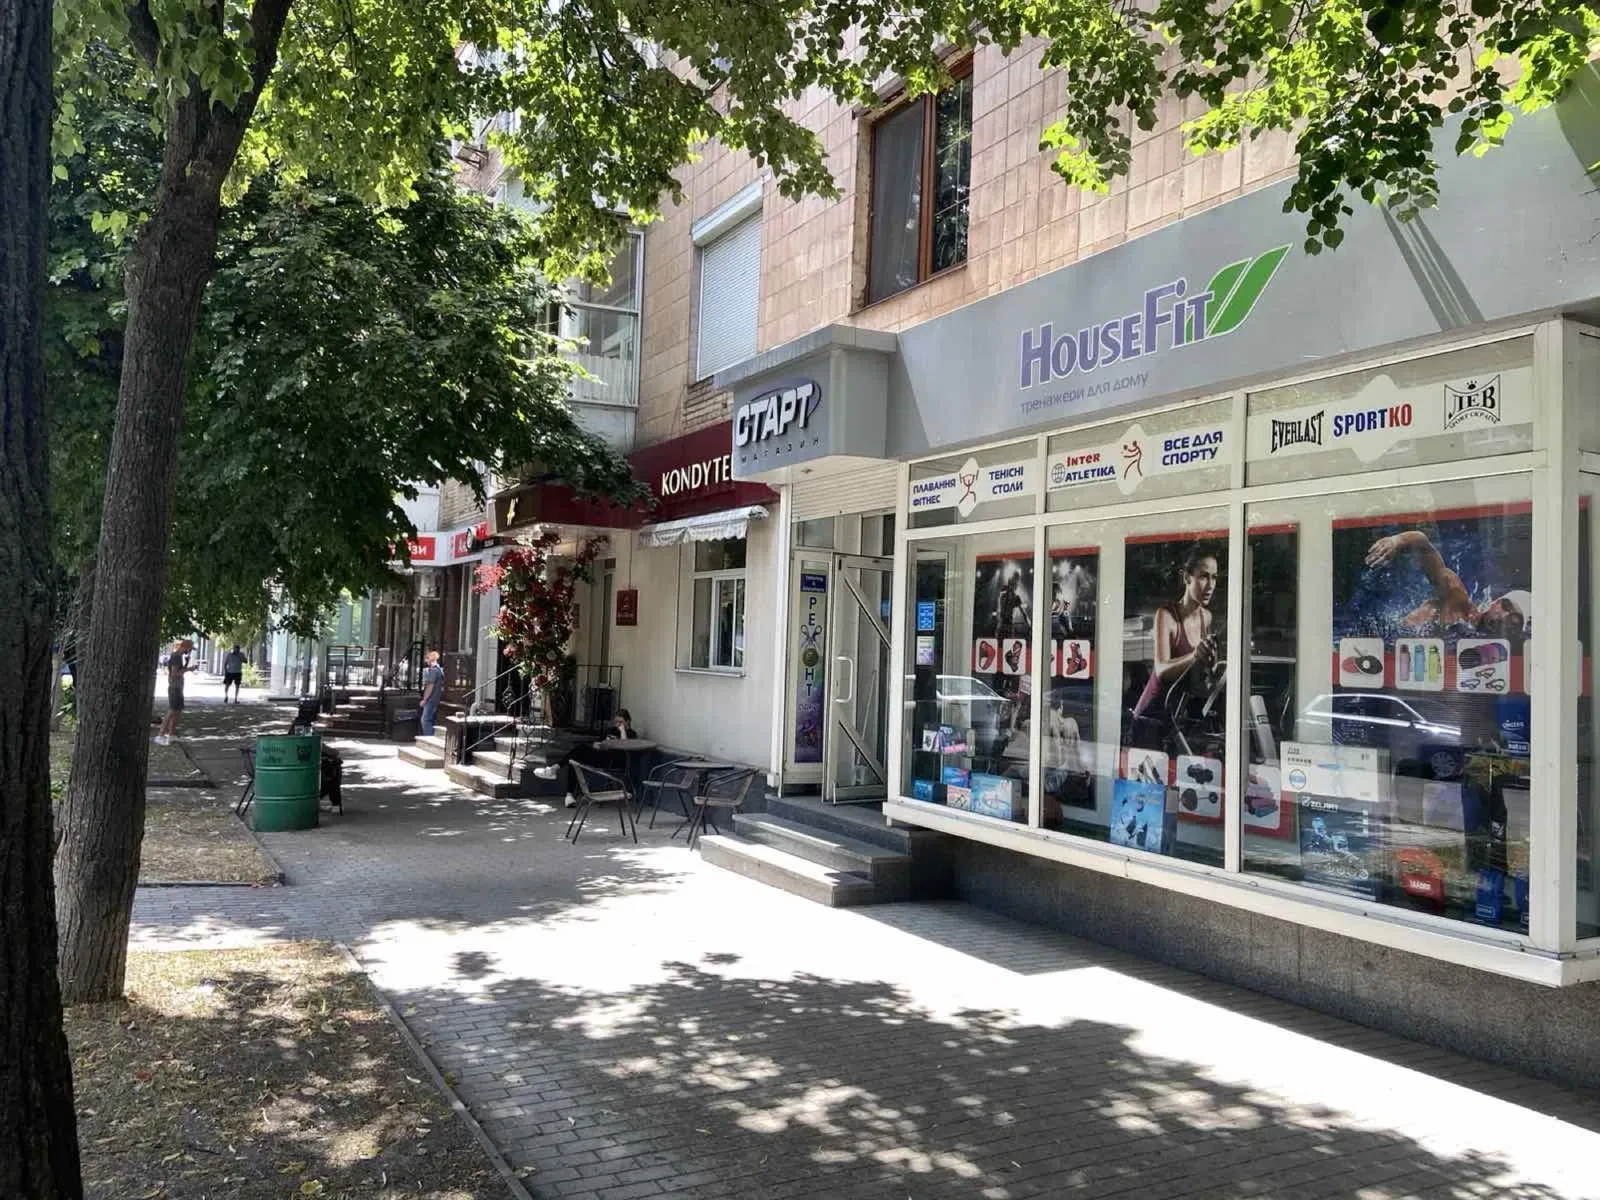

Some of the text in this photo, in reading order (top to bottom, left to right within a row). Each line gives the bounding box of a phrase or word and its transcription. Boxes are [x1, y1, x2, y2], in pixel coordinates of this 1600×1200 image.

[1020, 372, 1149, 415] тренажери для дому
[735, 383, 814, 447] СТАРТ
[1333, 404, 1413, 437] SPORTKO
[1163, 430, 1223, 451] ВСЕ ДЛЯ
[1271, 410, 1324, 453] EVERLAST
[1162, 447, 1219, 467] СПОРТУ
[988, 466, 1024, 481] ТЕНІСНІ
[1064, 466, 1115, 483] ATLETIKA
[913, 478, 957, 494] ПЛАВАННЯ
[992, 481, 1024, 495] СТОЛИ
[912, 494, 941, 507] ФІТНЕС
